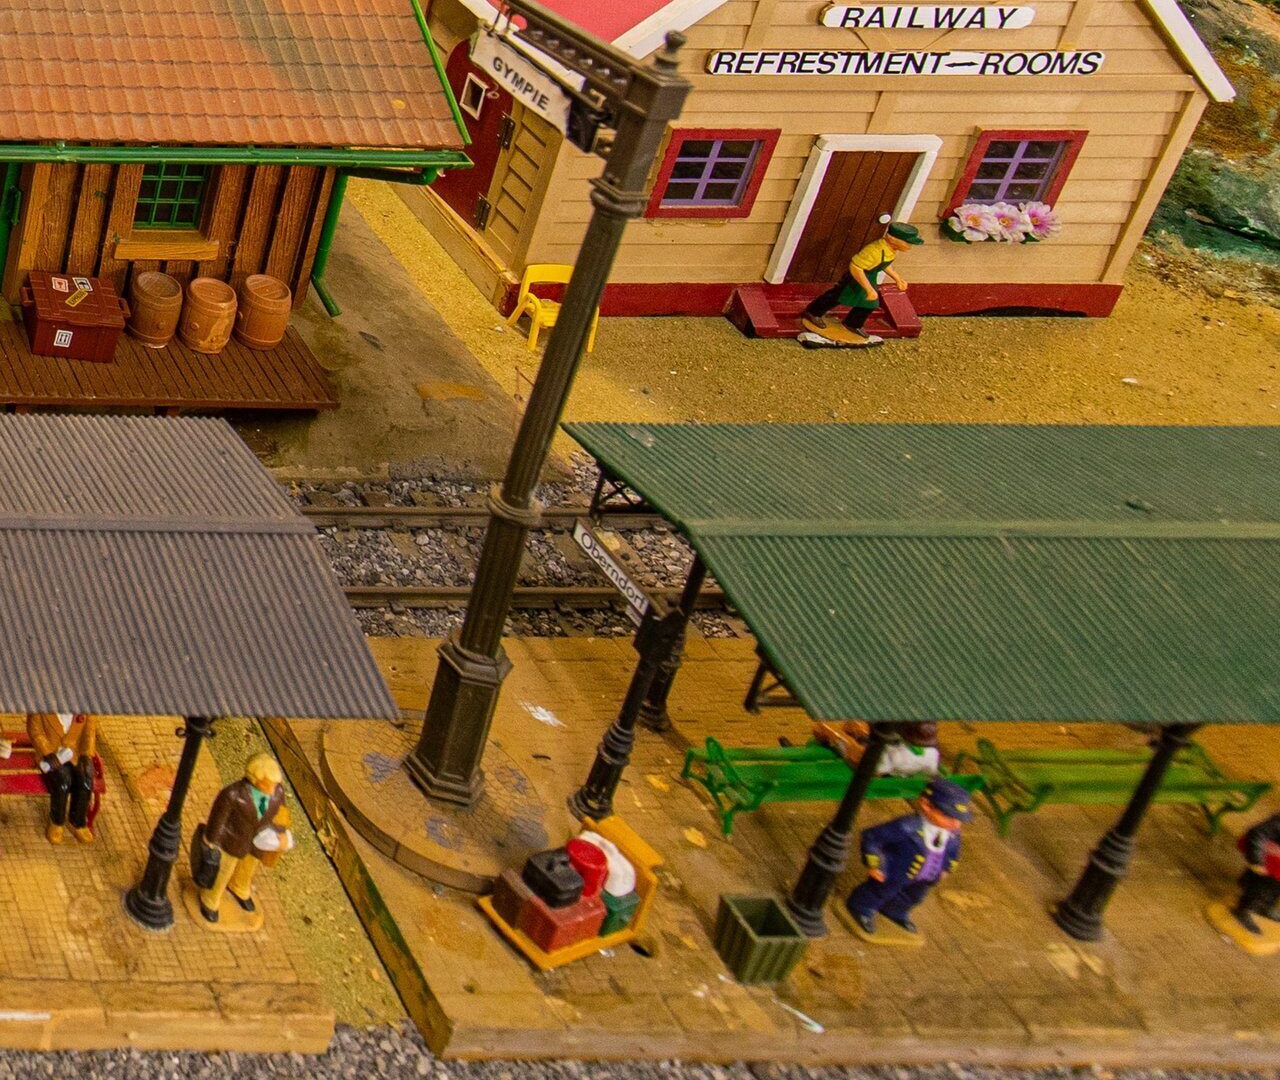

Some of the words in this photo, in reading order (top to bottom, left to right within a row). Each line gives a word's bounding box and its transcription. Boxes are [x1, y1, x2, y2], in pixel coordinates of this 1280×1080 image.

[839, 6, 1019, 29] RAILWAY
[493, 55, 550, 111] GYMPIE
[712, 51, 951, 74] REFRESTMENT
[978, 51, 1103, 75] ROOMS
[581, 532, 645, 609] Oberndorf
